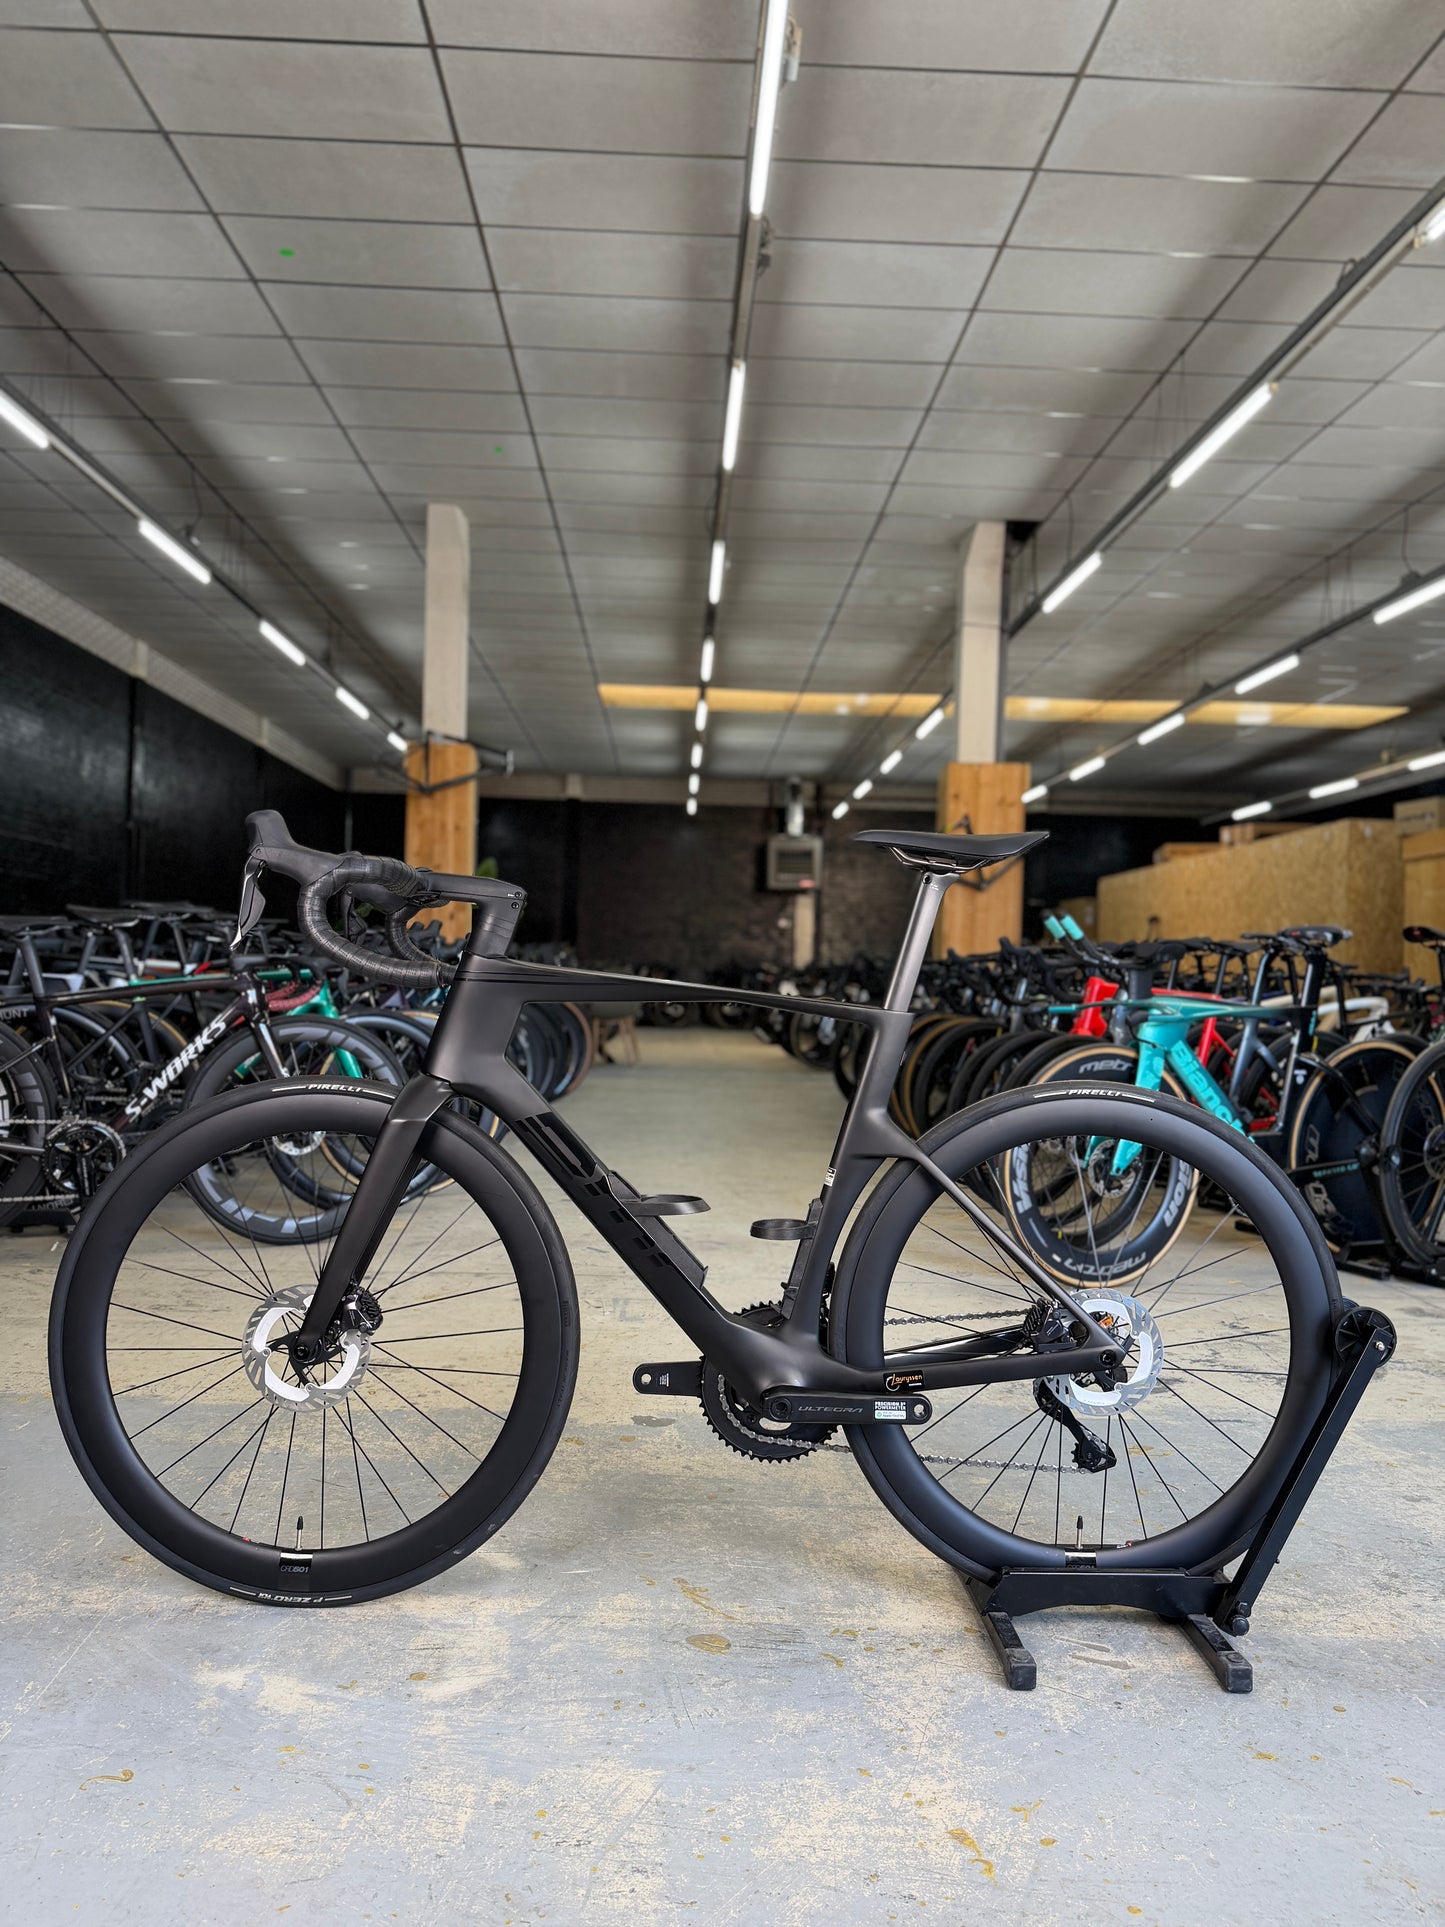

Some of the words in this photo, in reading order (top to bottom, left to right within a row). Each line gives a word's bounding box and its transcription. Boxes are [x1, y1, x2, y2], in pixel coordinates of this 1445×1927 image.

[123, 1014, 229, 1121] S-WORKS
[307, 1083, 362, 1093] PIRELLI
[1068, 1088, 1122, 1097] PIRELLI
[797, 1405, 864, 1414] ULTEGRA
